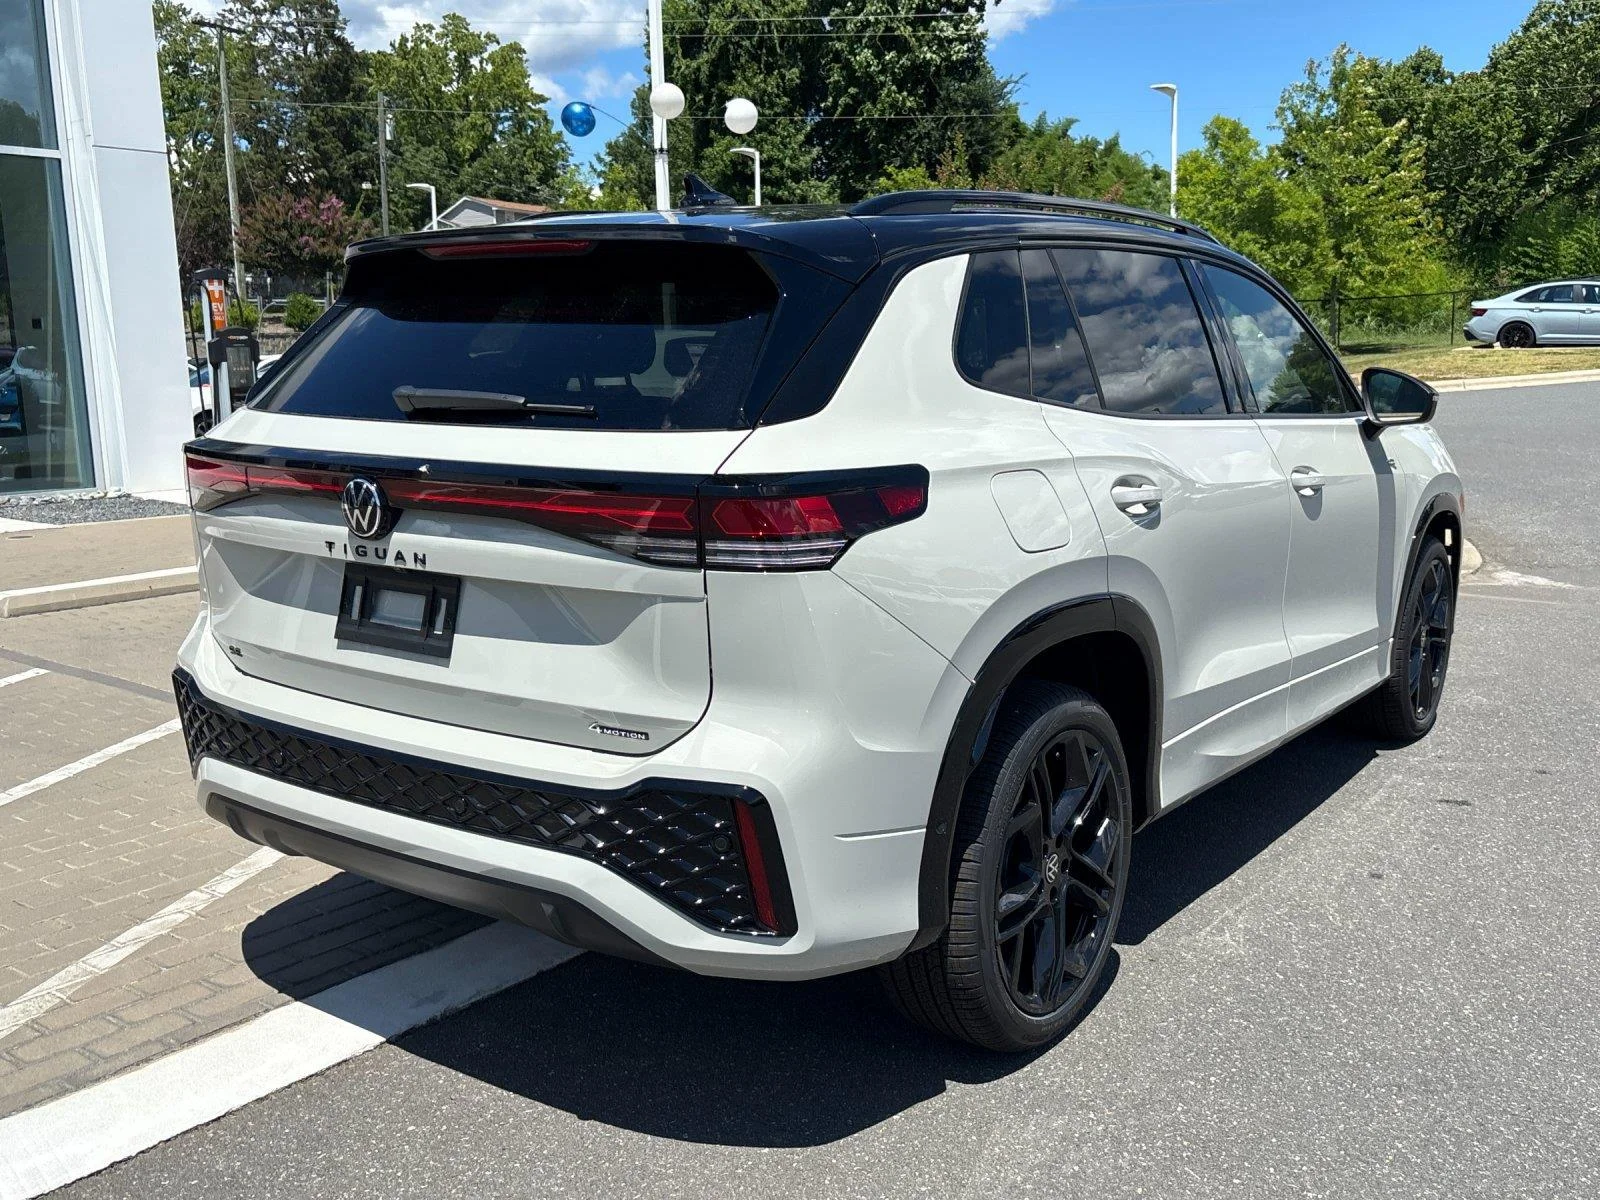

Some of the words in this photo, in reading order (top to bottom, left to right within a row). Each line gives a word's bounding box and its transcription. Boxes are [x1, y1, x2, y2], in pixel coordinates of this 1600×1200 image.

[212, 302, 224, 312] EV
[325, 541, 427, 566] TIGUAN
[588, 722, 646, 740] 4MOTION
